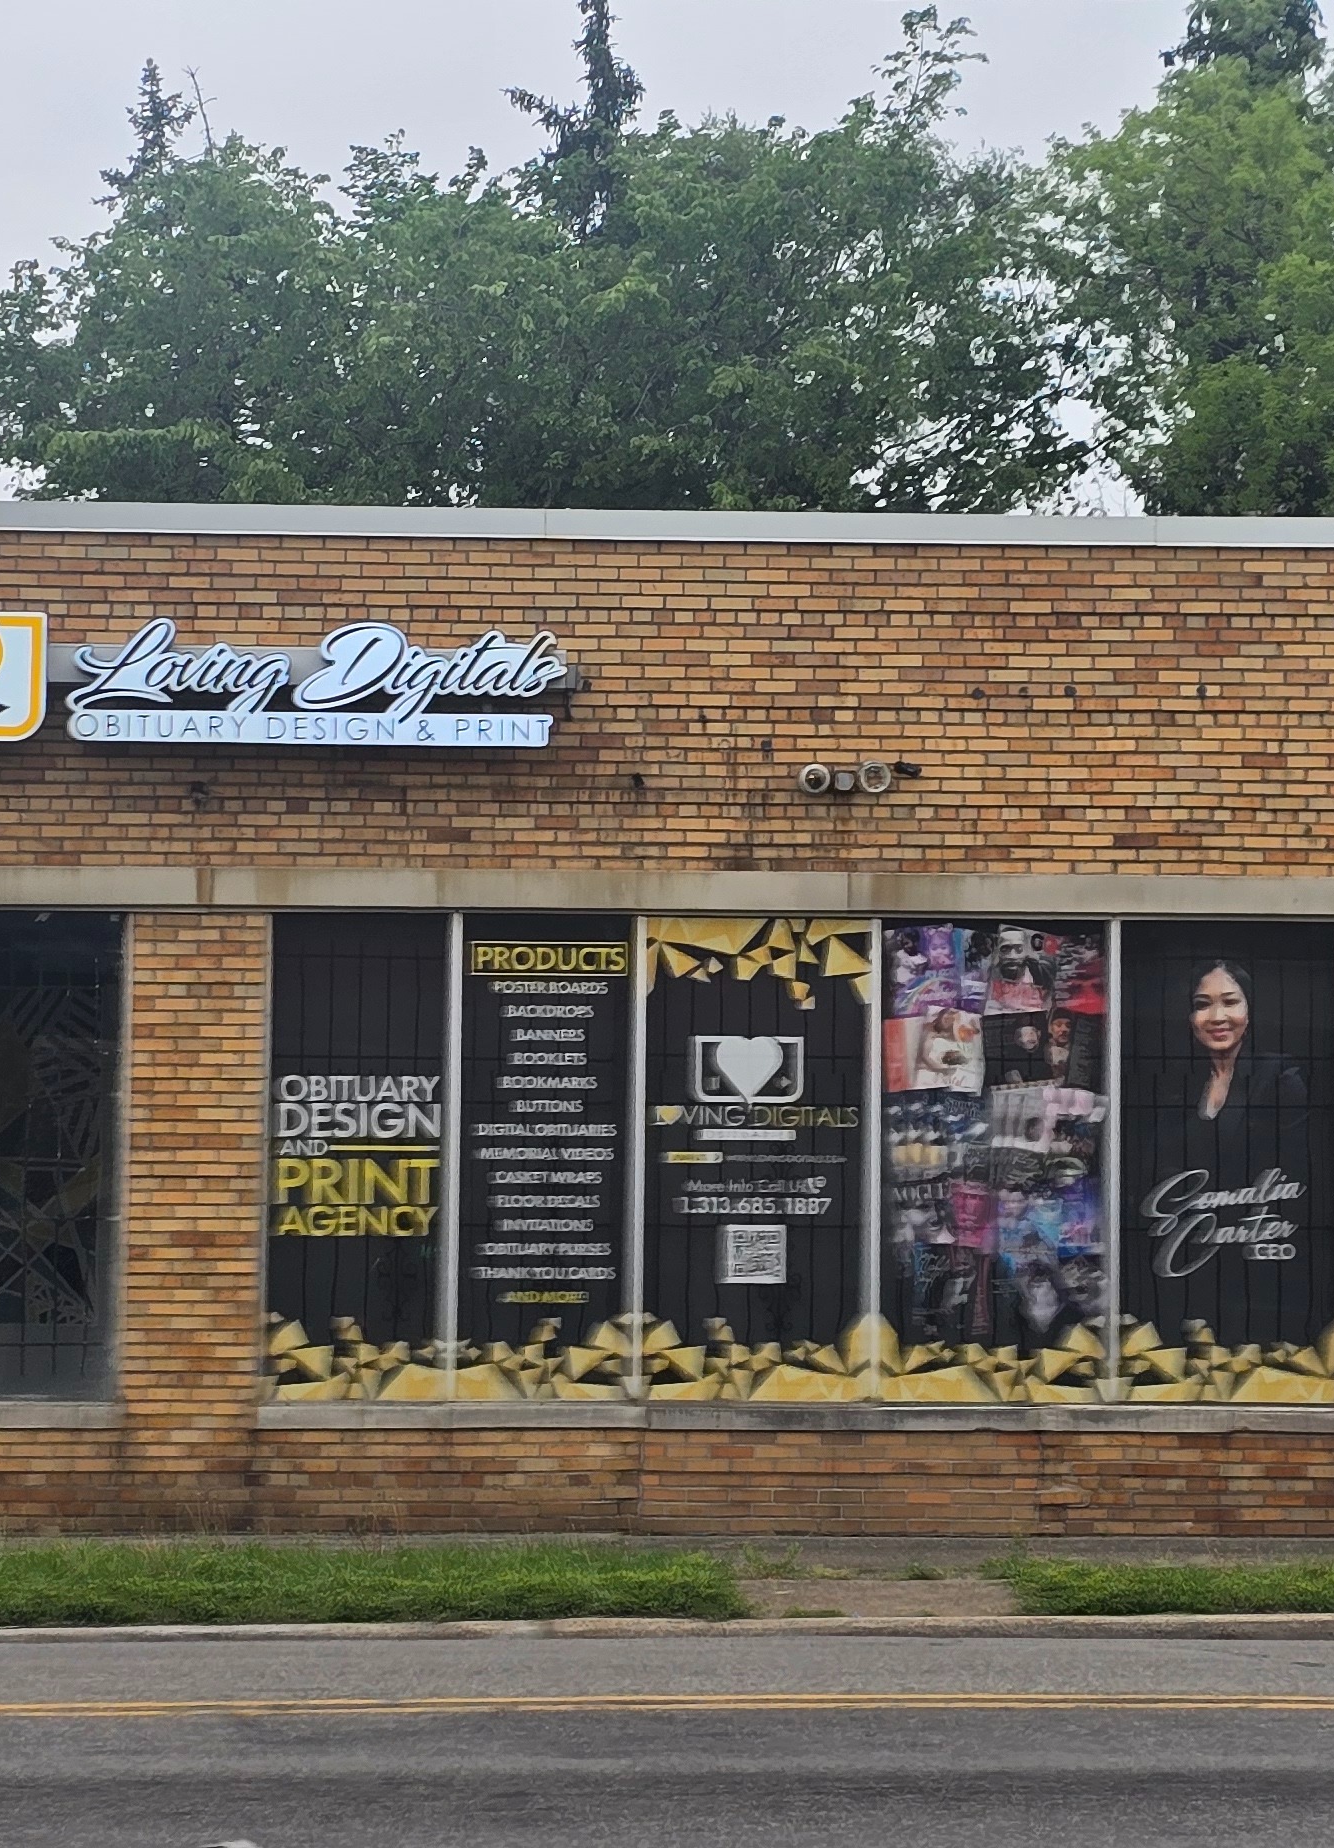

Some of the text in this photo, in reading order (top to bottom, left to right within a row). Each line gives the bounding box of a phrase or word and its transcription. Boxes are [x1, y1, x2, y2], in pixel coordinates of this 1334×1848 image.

[67, 617, 567, 722] Loving Digitals
[75, 713, 550, 742] OBITUARY DESIGN & PRINT
[476, 947, 626, 971] PRODUCTS
[548, 981, 608, 994] BOARDS
[505, 1005, 594, 1018] BACKDROPS
[513, 1029, 586, 1042] BANNERS
[509, 1052, 587, 1065] BOOKLETS
[279, 1074, 440, 1102] OBITUARY
[500, 1076, 598, 1089] BOOKMARKS
[513, 1100, 584, 1113] BUTTONS
[277, 1102, 441, 1138] DESIGN
[753, 1105, 859, 1128] DIGITALS
[475, 1124, 617, 1136] DIGITAL OBITUARIES
[280, 1139, 328, 1156] AND
[478, 1148, 614, 1160] MEMORIAL VIDEOS
[278, 1158, 441, 1204] PRINT
[492, 1171, 548, 1184] CASKET
[685, 1179, 725, 1193] More
[277, 1205, 440, 1236] AGENCY
[499, 1219, 594, 1232] INVITATIONS
[1157, 1206, 1299, 1278] Carter
[1250, 1244, 1297, 1260] CEO
